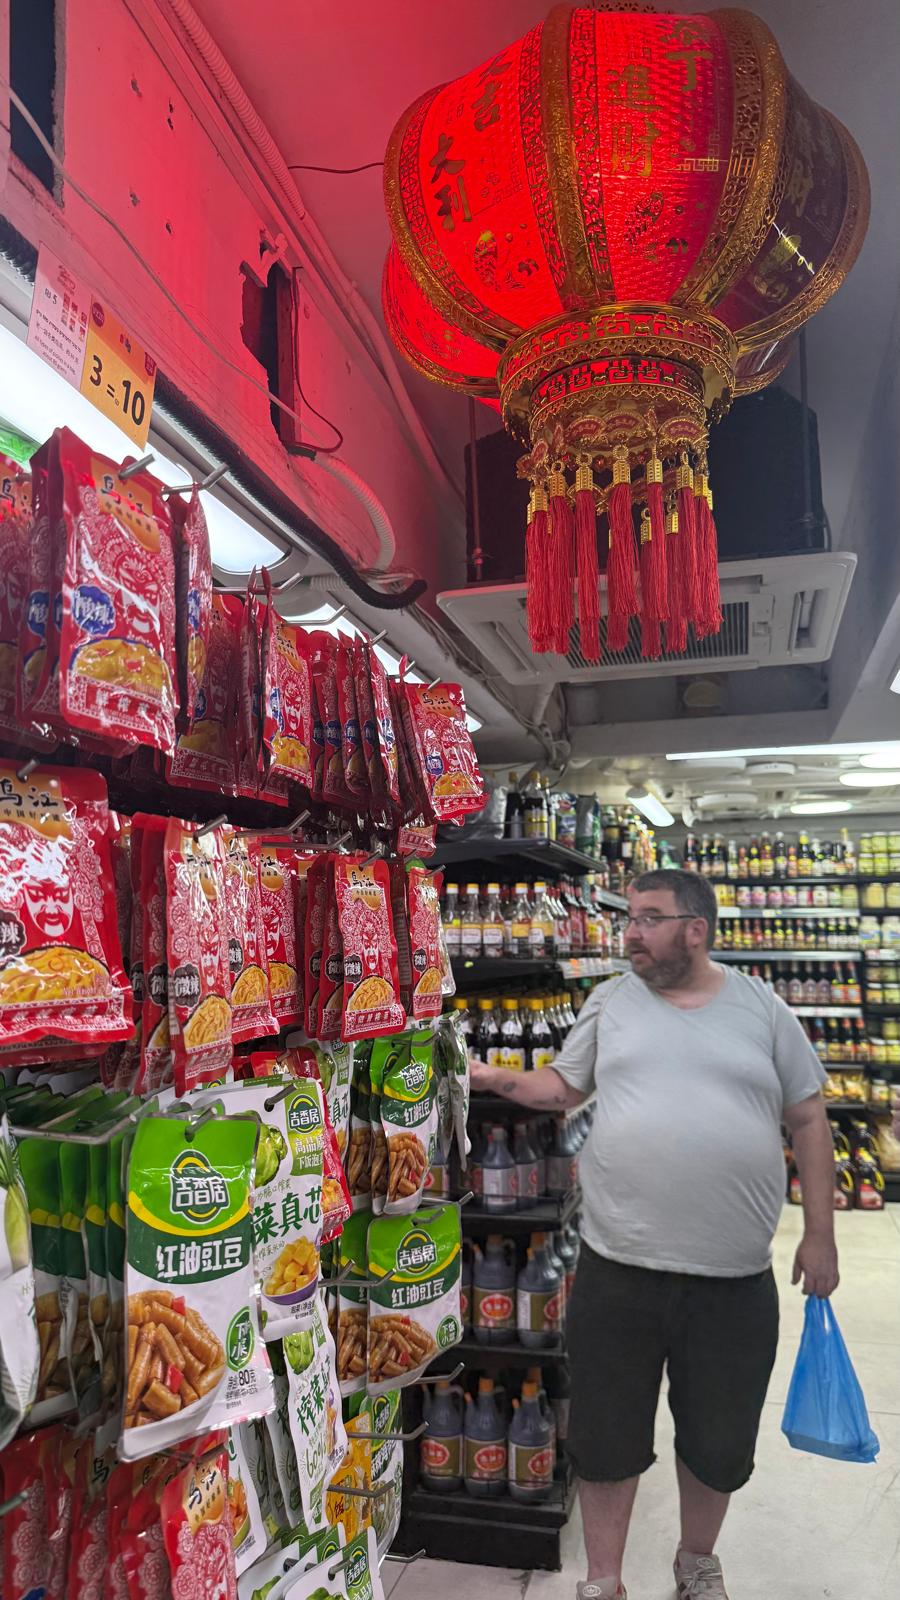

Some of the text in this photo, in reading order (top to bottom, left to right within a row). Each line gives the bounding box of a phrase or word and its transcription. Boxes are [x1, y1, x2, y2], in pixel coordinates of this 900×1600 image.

[52, 294, 59, 305] 5
[89, 354, 103, 386] 3
[121, 379, 145, 426] 10
[0, 922, 20, 944] 辣
[174, 975, 200, 997] 微辣
[286, 1107, 320, 1127] 吉香居
[174, 1176, 227, 1207] 吉香居
[155, 1236, 243, 1279] 红油豇豆
[399, 1245, 435, 1267] 吉香居
[391, 1278, 445, 1308] 红油豇豆
[238, 1369, 250, 1386] 80
